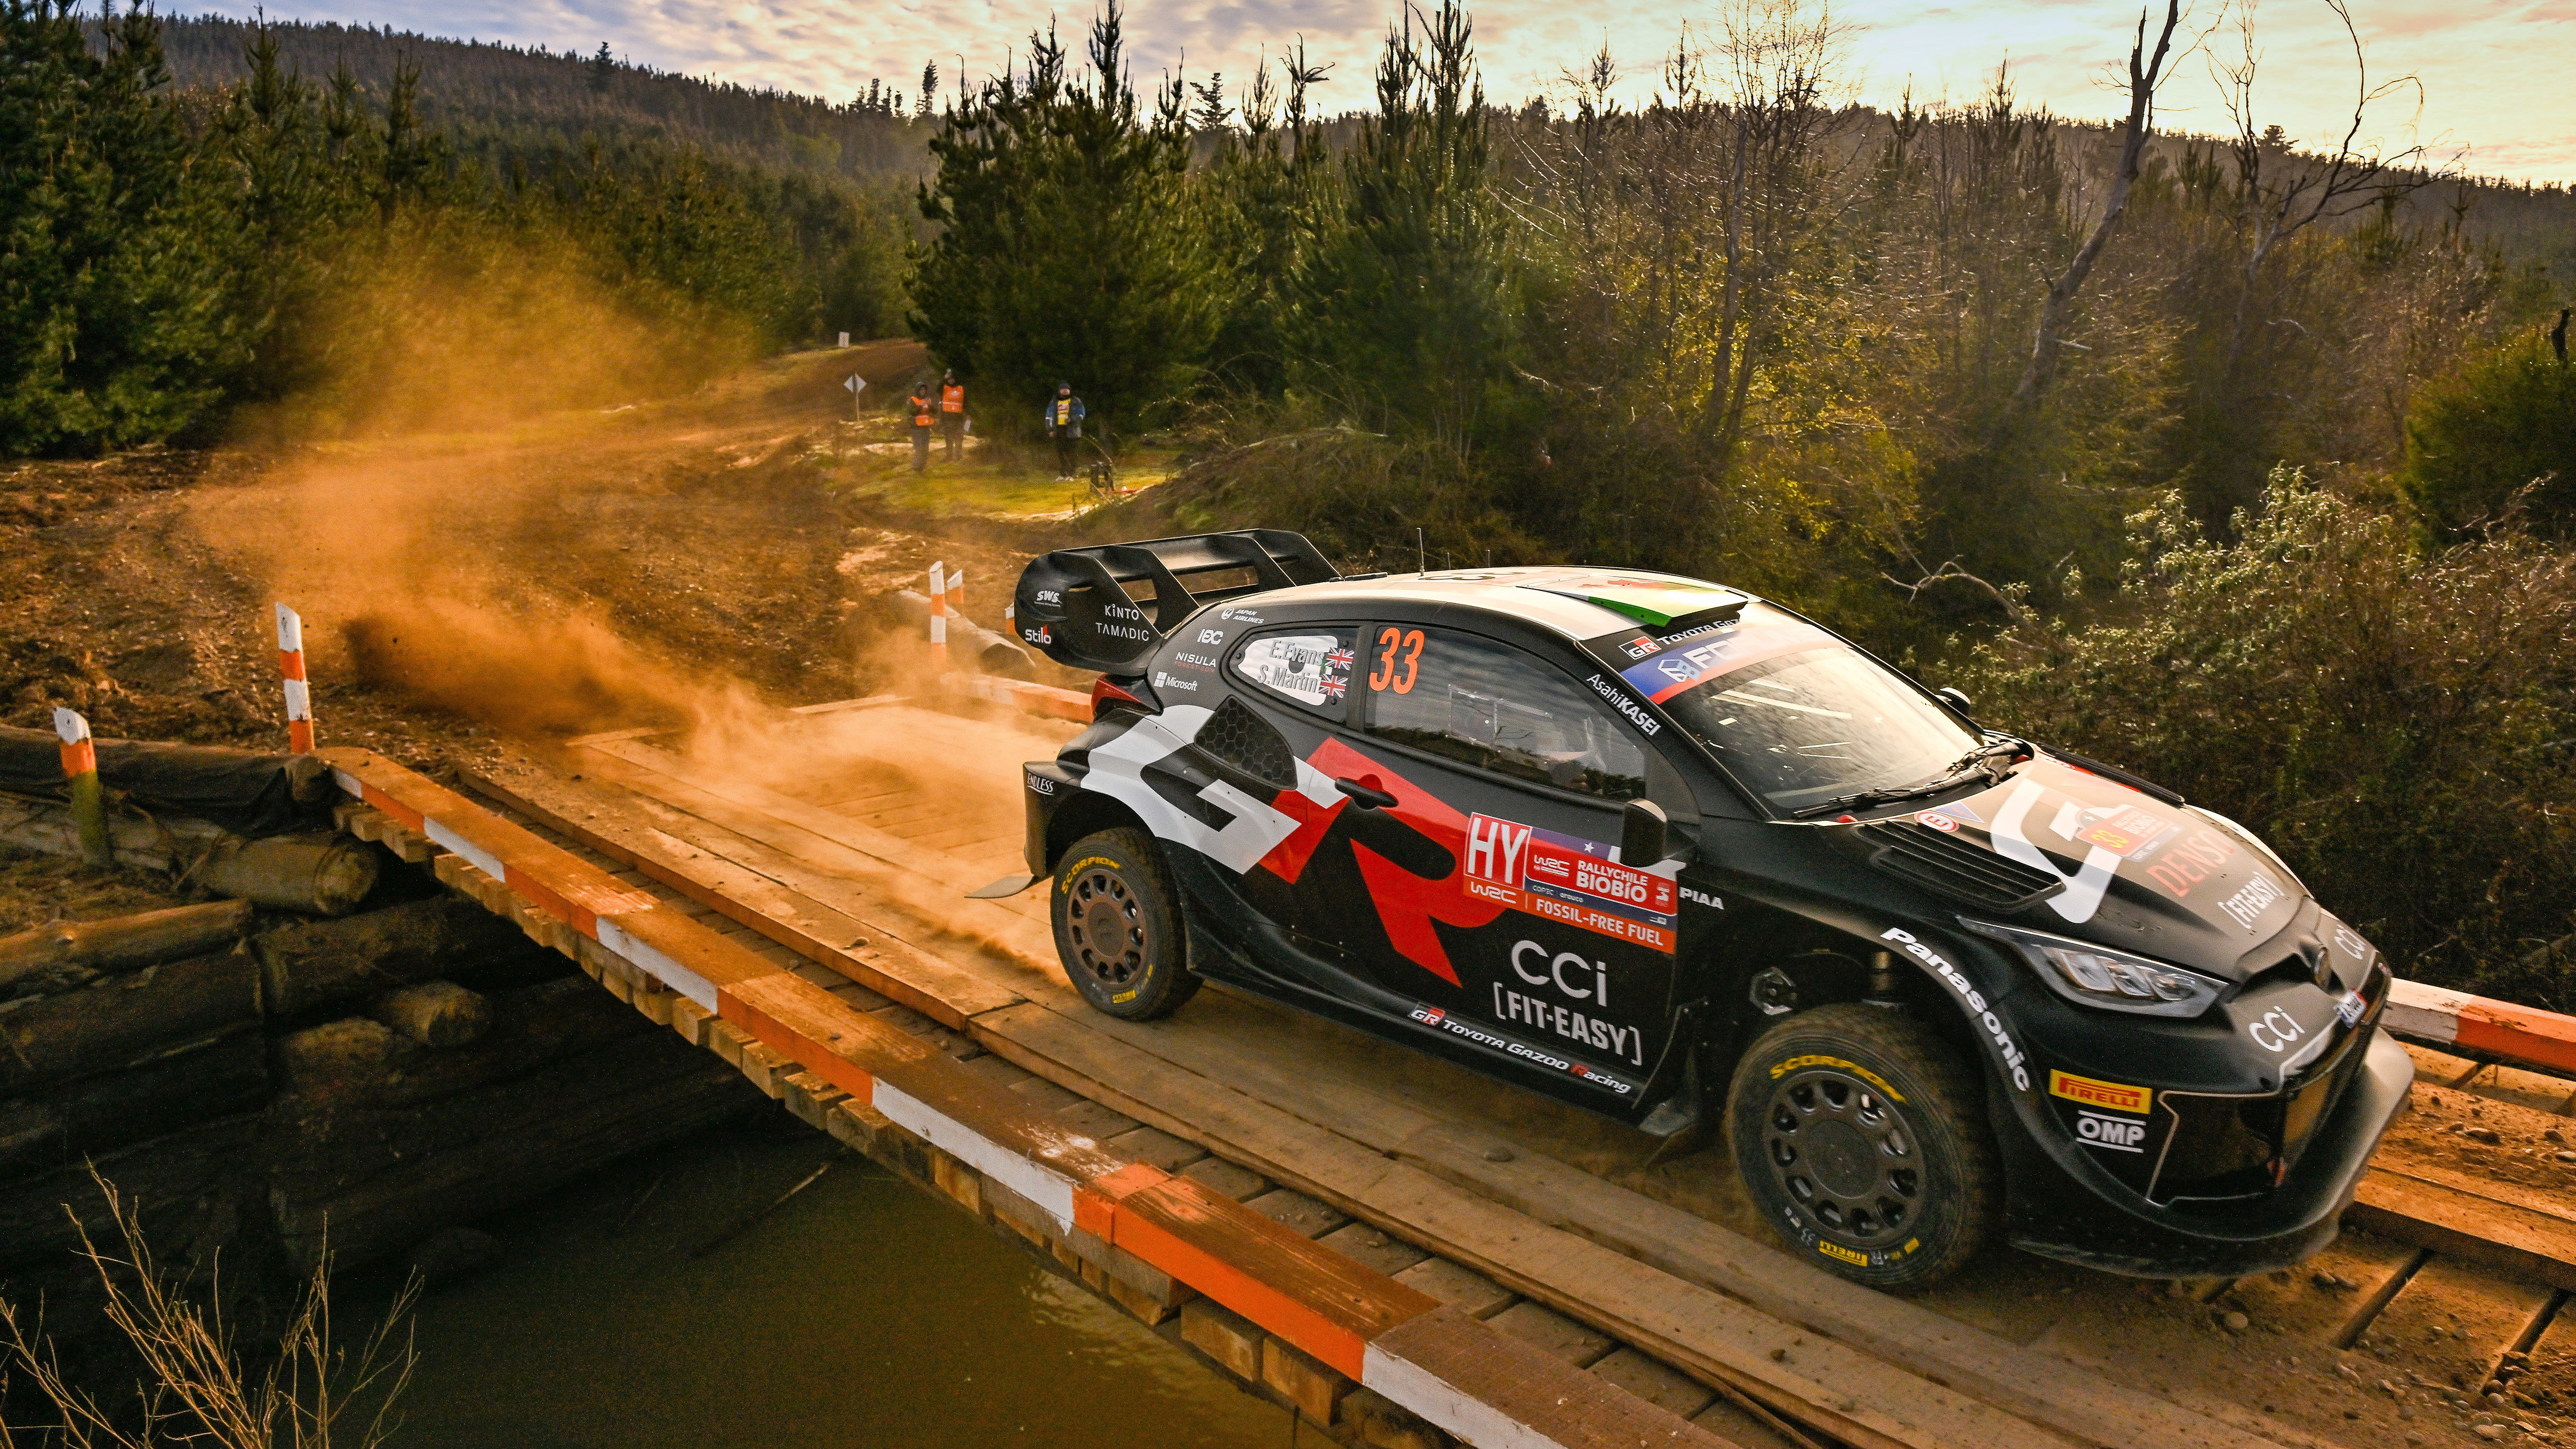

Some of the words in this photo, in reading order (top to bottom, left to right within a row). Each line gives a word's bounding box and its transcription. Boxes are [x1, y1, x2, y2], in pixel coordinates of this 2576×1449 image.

[1037, 591, 1062, 603] SWS
[1232, 614, 1265, 625] AIRLINES
[1025, 625, 1052, 644] Stilo
[1095, 622, 1149, 642] TAMADIC
[1656, 624, 1714, 645] TOYOTA
[1176, 652, 1216, 668] NISULA
[1369, 628, 1425, 695] 33
[1165, 676, 1198, 692] Microsoft
[1027, 772, 1055, 793] ENDLESS
[1468, 817, 1529, 884] HY
[2090, 830, 2129, 849] 33
[1534, 854, 1570, 871] WRC
[2146, 830, 2237, 898] DENSO
[1062, 856, 1121, 895] SCORPION
[1470, 881, 1517, 904] WRC
[1679, 887, 1724, 910] PIAA
[1536, 898, 1624, 935] FOSSIL-FREE
[1628, 923, 1664, 947] FUEL
[1879, 927, 2030, 1092] Panasonic
[1411, 1009, 1440, 1025] GR
[1443, 1019, 1505, 1049] TOYOTA
[1507, 1043, 1570, 1070] GAZOO
[1570, 1064, 1632, 1094] Racing
[2059, 1076, 2142, 1108] PIRELLI
[2077, 1117, 2146, 1146] OMP
[1819, 1240, 1868, 1267] PIRELLI
